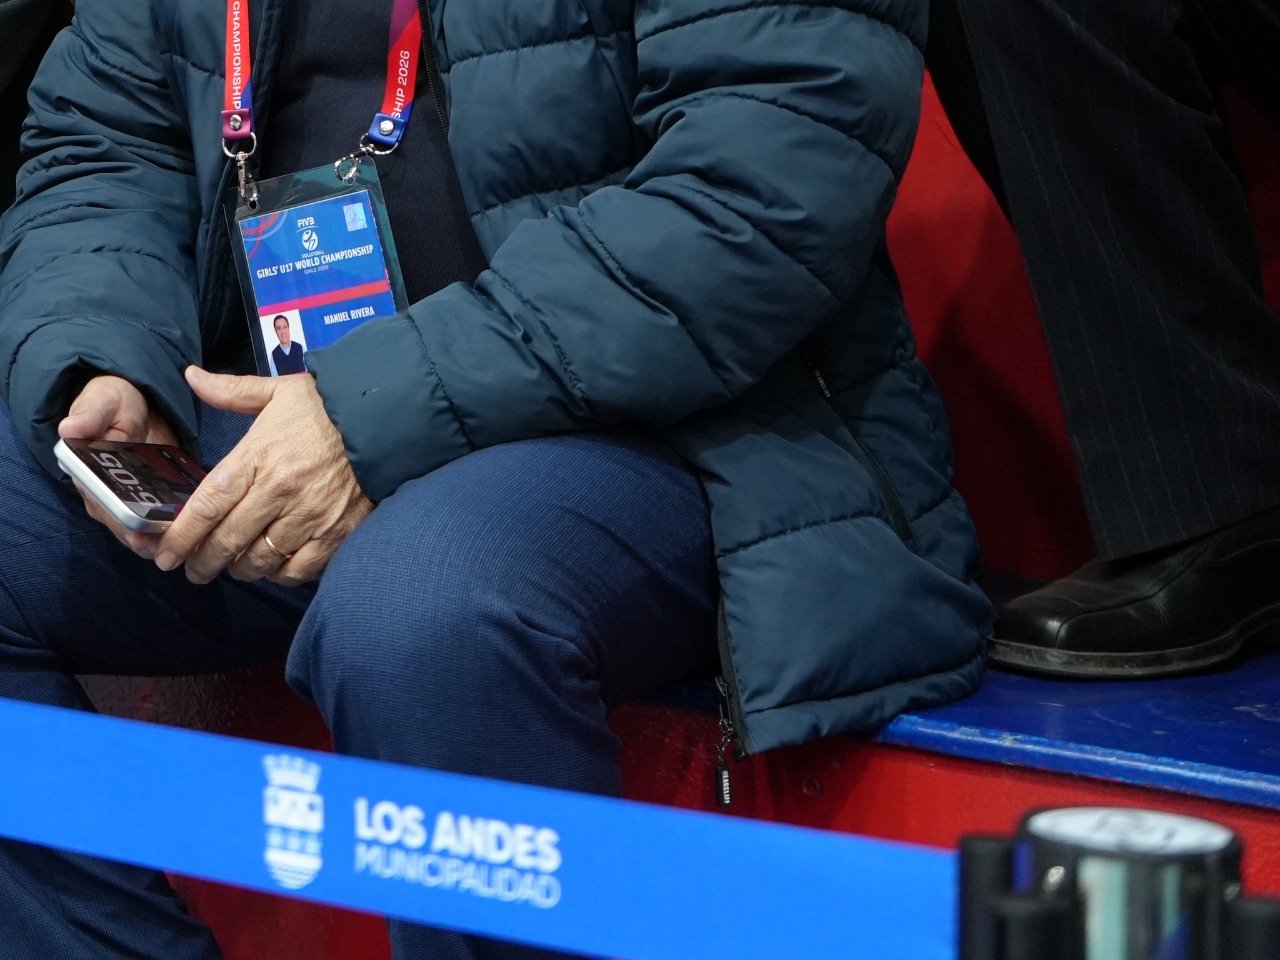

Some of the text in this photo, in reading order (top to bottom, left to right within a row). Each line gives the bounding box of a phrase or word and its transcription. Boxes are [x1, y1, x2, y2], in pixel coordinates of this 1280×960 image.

[232, 1, 242, 110] CHAMPIONSHIP
[398, 50, 410, 86] 2026
[297, 216, 315, 229] FIVB
[256, 244, 374, 279] GIRLS' U17 WORLD CHAMPIONSHIP
[301, 249, 325, 259] VOLLEYBALL
[324, 305, 375, 326] MANUEL RIVERA
[90, 452, 163, 507] 5:05
[354, 796, 563, 873] LOS ANDES
[353, 841, 563, 909] MUNICIPALIDAD
